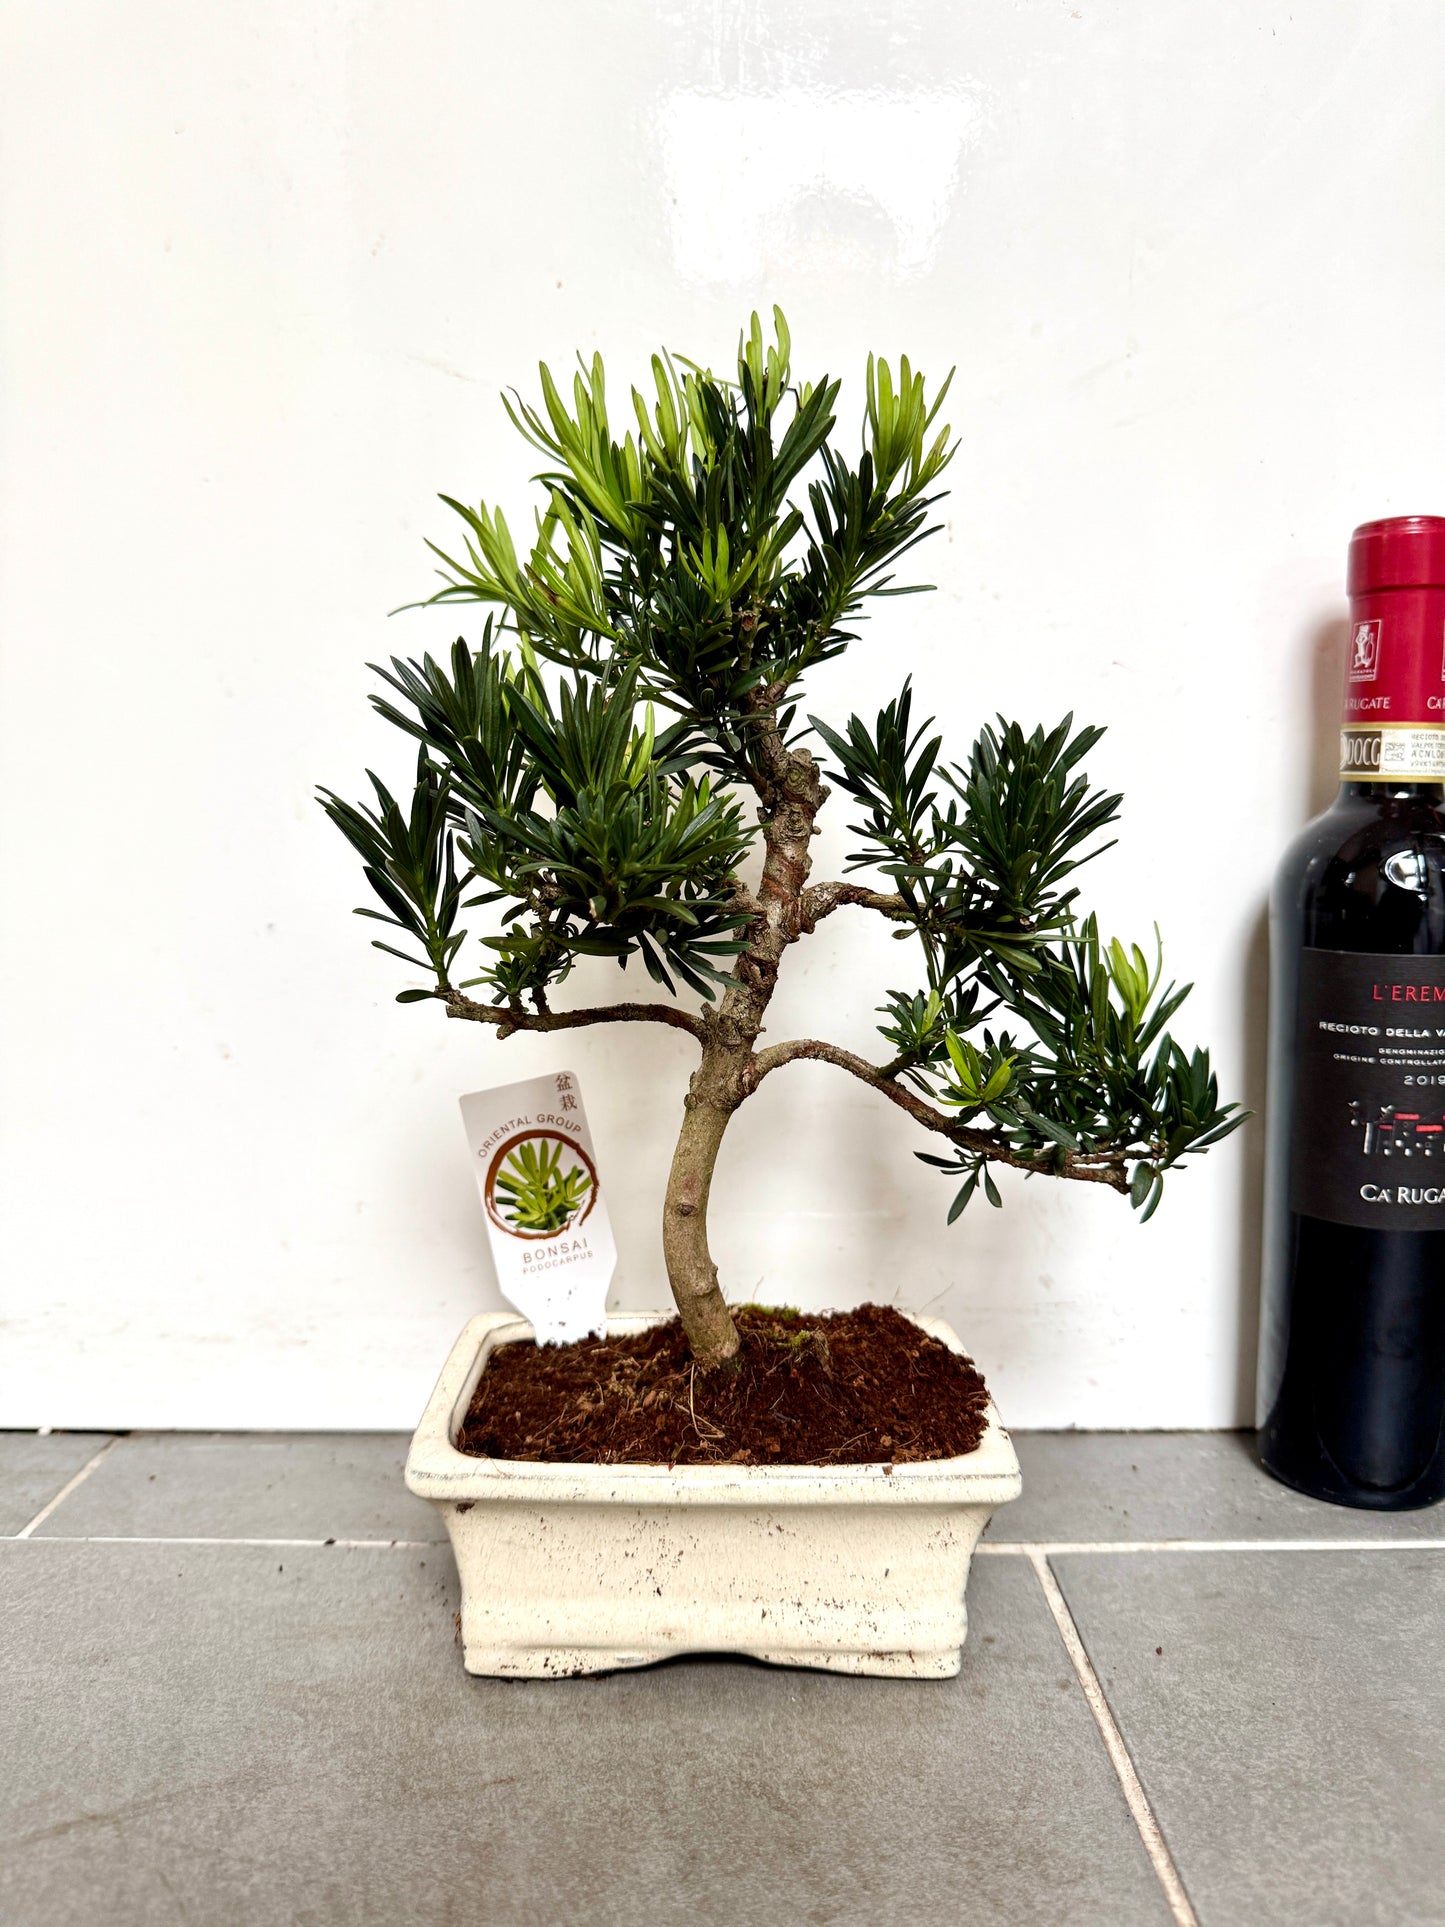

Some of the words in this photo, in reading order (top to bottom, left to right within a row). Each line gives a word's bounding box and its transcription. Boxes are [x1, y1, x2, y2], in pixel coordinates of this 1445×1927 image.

[1319, 1021, 1380, 1036] RECIOTO
[1385, 1028, 1431, 1038] DELLA
[1333, 1053, 1376, 1064] ORIGINE
[555, 1073, 577, 1111] 盆栽
[1403, 1075, 1445, 1086] 2019
[479, 1116, 532, 1158] ORIENTAL
[536, 1113, 582, 1133] GROUP
[523, 1237, 588, 1264] BONSAI
[523, 1250, 593, 1275] PODOCARPUS
